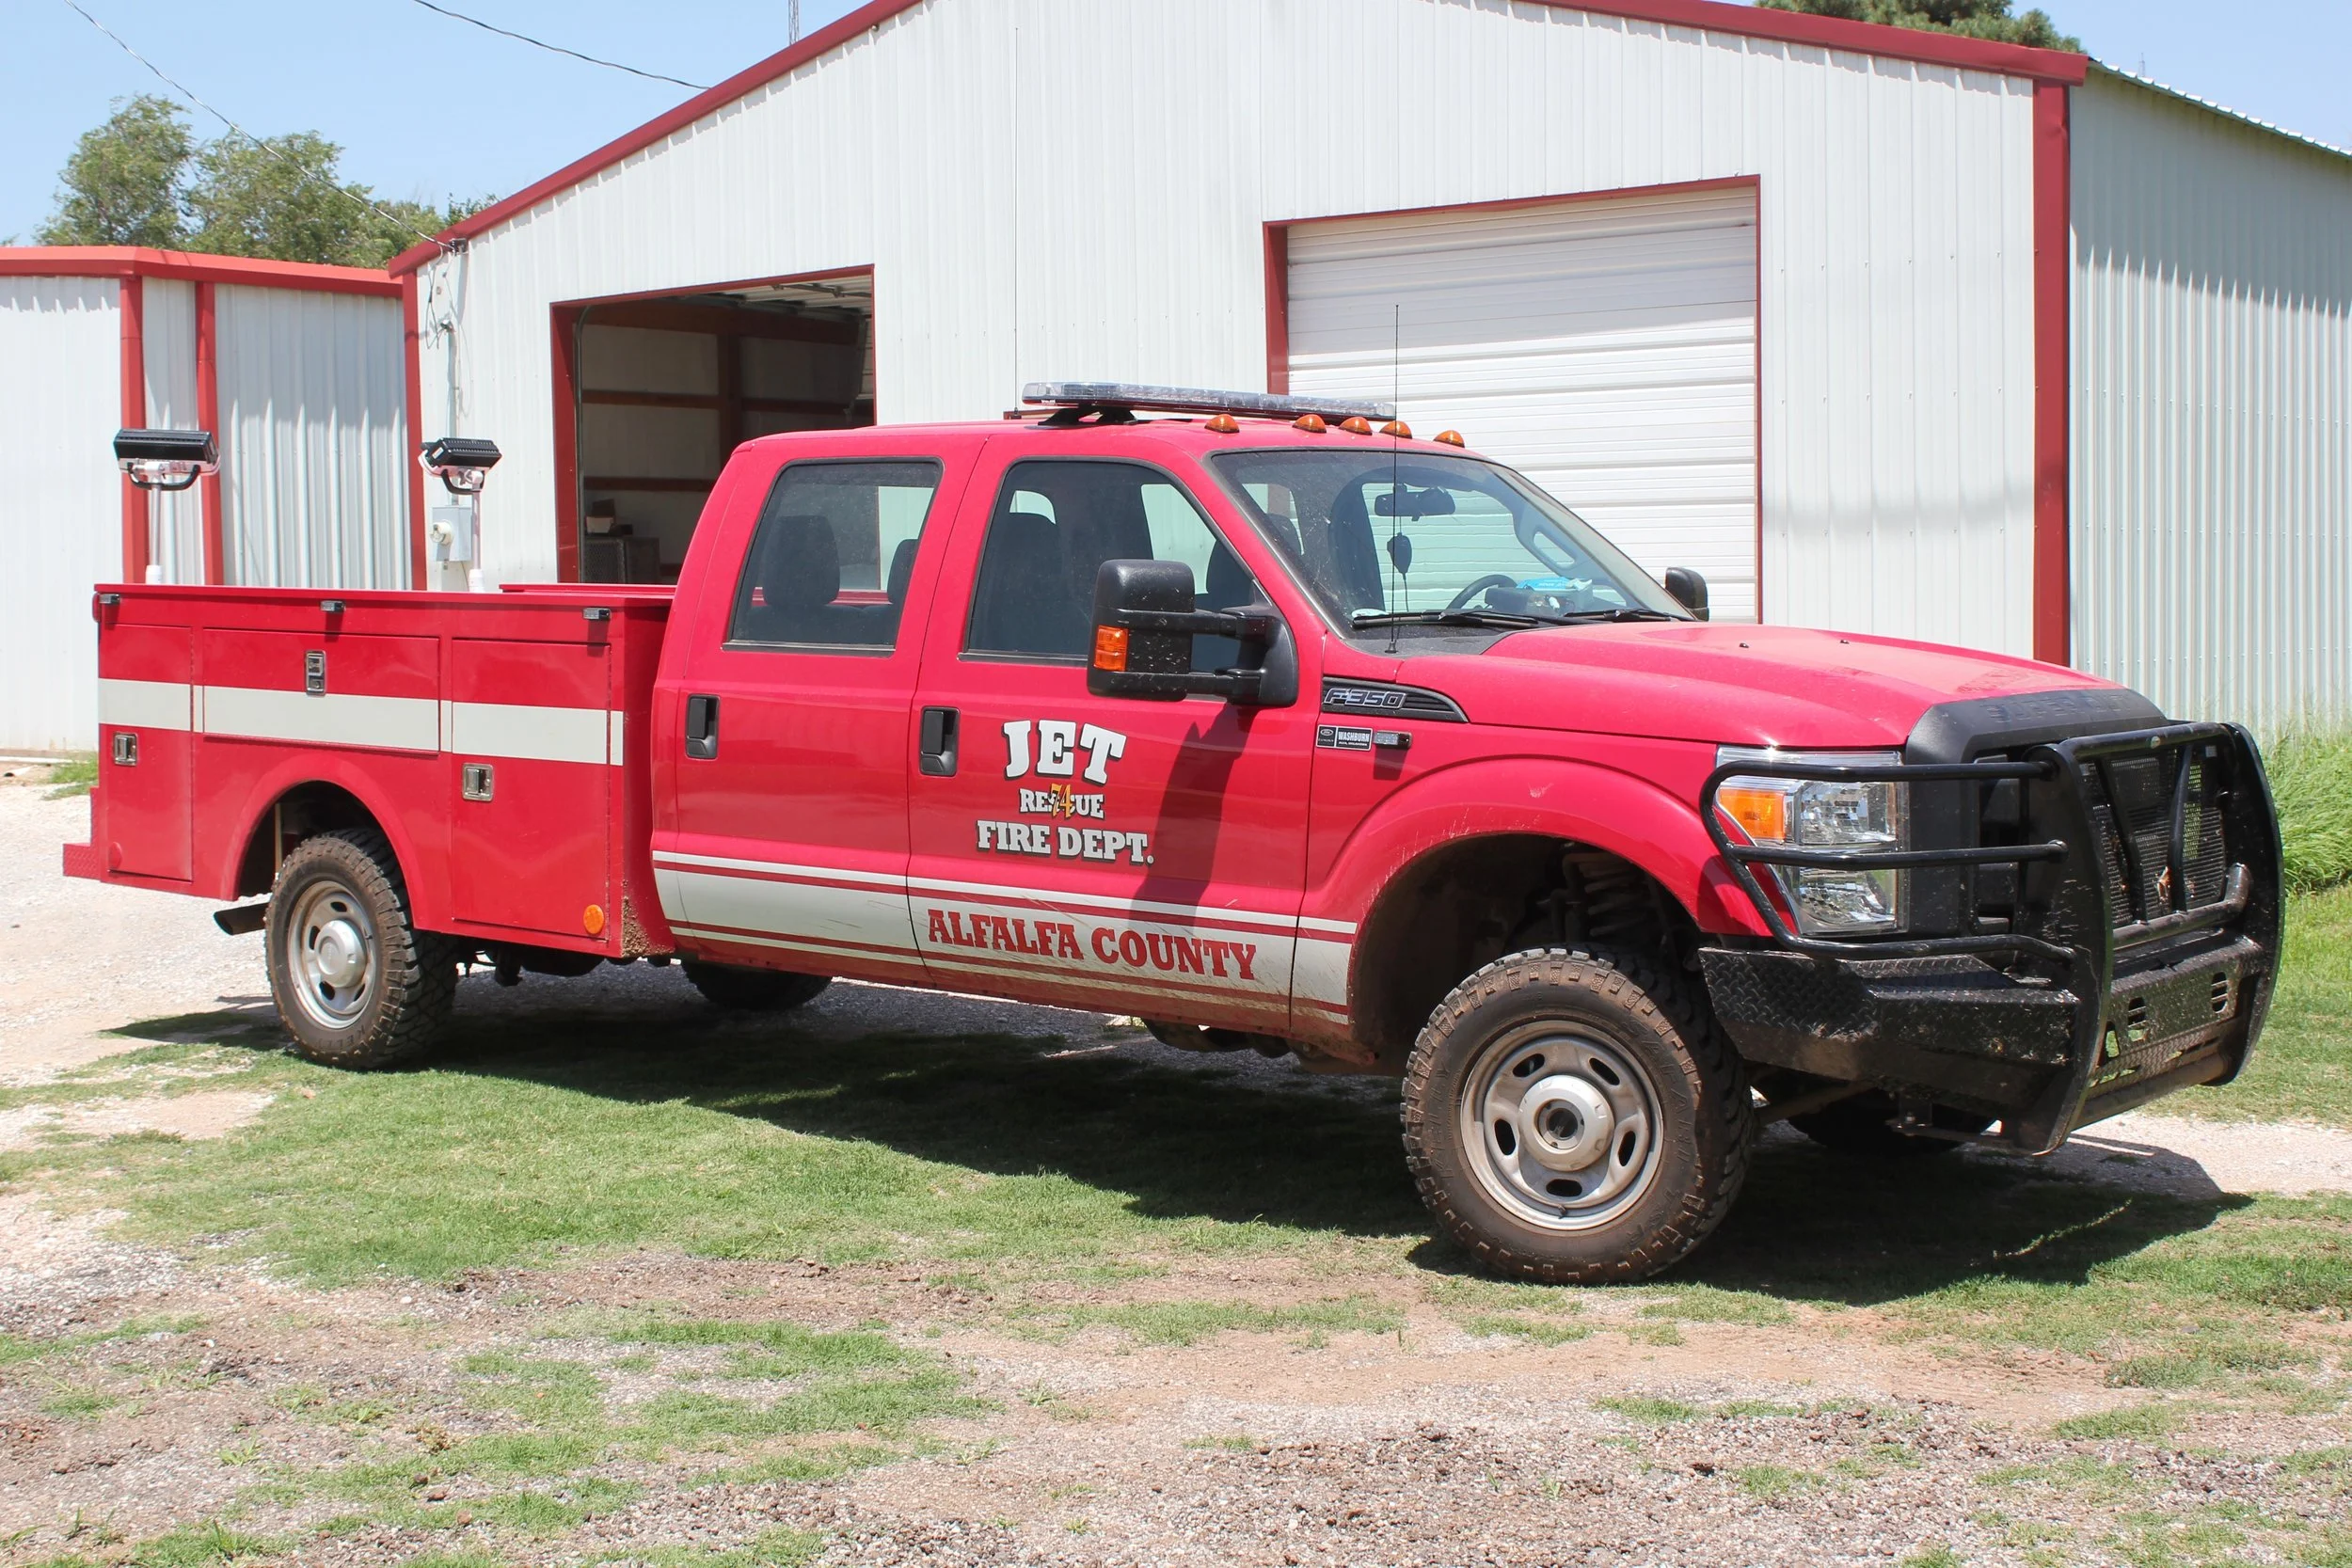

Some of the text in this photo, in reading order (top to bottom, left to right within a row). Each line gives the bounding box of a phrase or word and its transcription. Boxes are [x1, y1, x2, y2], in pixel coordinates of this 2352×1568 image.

[1324, 688, 1406, 708] F-350
[1002, 720, 1127, 785] JET
[1338, 731, 1371, 742] WASHBURN
[976, 820, 1155, 864] FIRE DEPT.
[928, 909, 1257, 980] ALFALFA COUNTY
